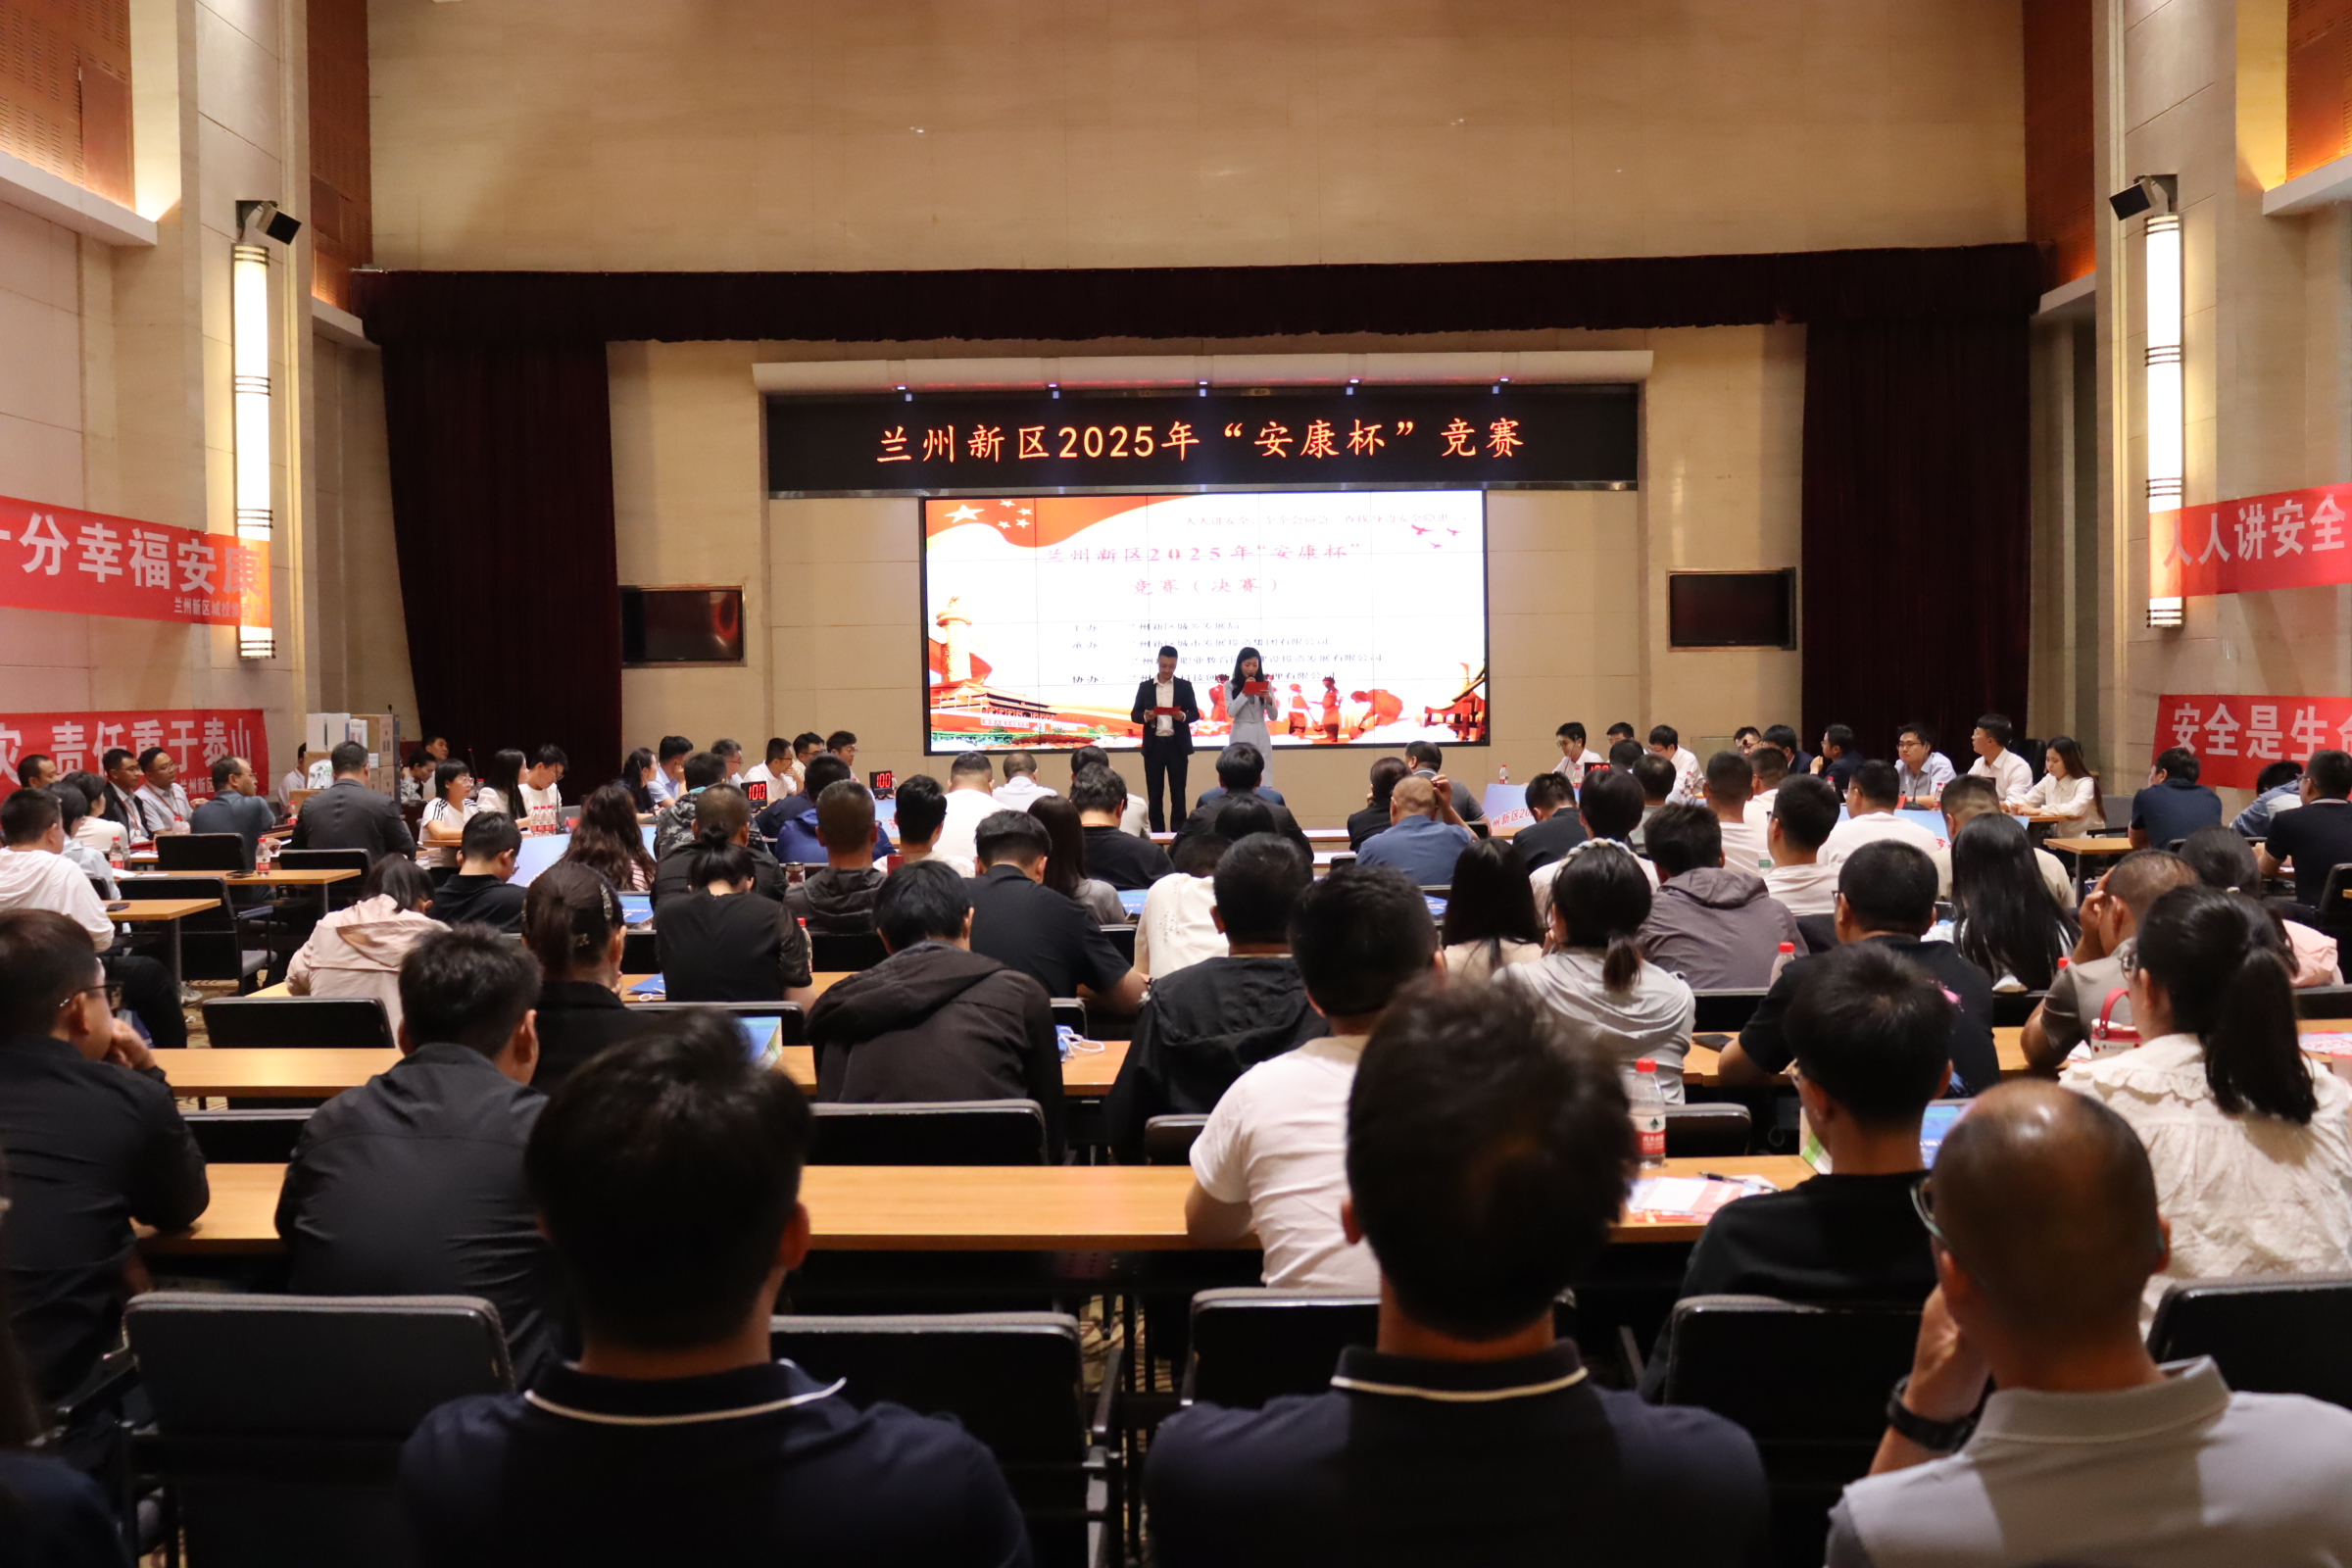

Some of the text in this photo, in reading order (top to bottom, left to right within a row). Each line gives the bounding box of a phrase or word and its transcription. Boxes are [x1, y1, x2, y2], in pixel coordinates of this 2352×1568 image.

[876, 417, 1524, 463] 兰州新区2025年“安康杯”竞赛
[2162, 494, 2346, 567] 人人讲安全
[1045, 543, 1360, 564] 兰州新区2025年“安康杯”
[51, 716, 252, 776] 责任重于泰山
[876, 772, 892, 788] 100
[749, 784, 766, 801] 100
[1492, 808, 1535, 828] 州新区20
